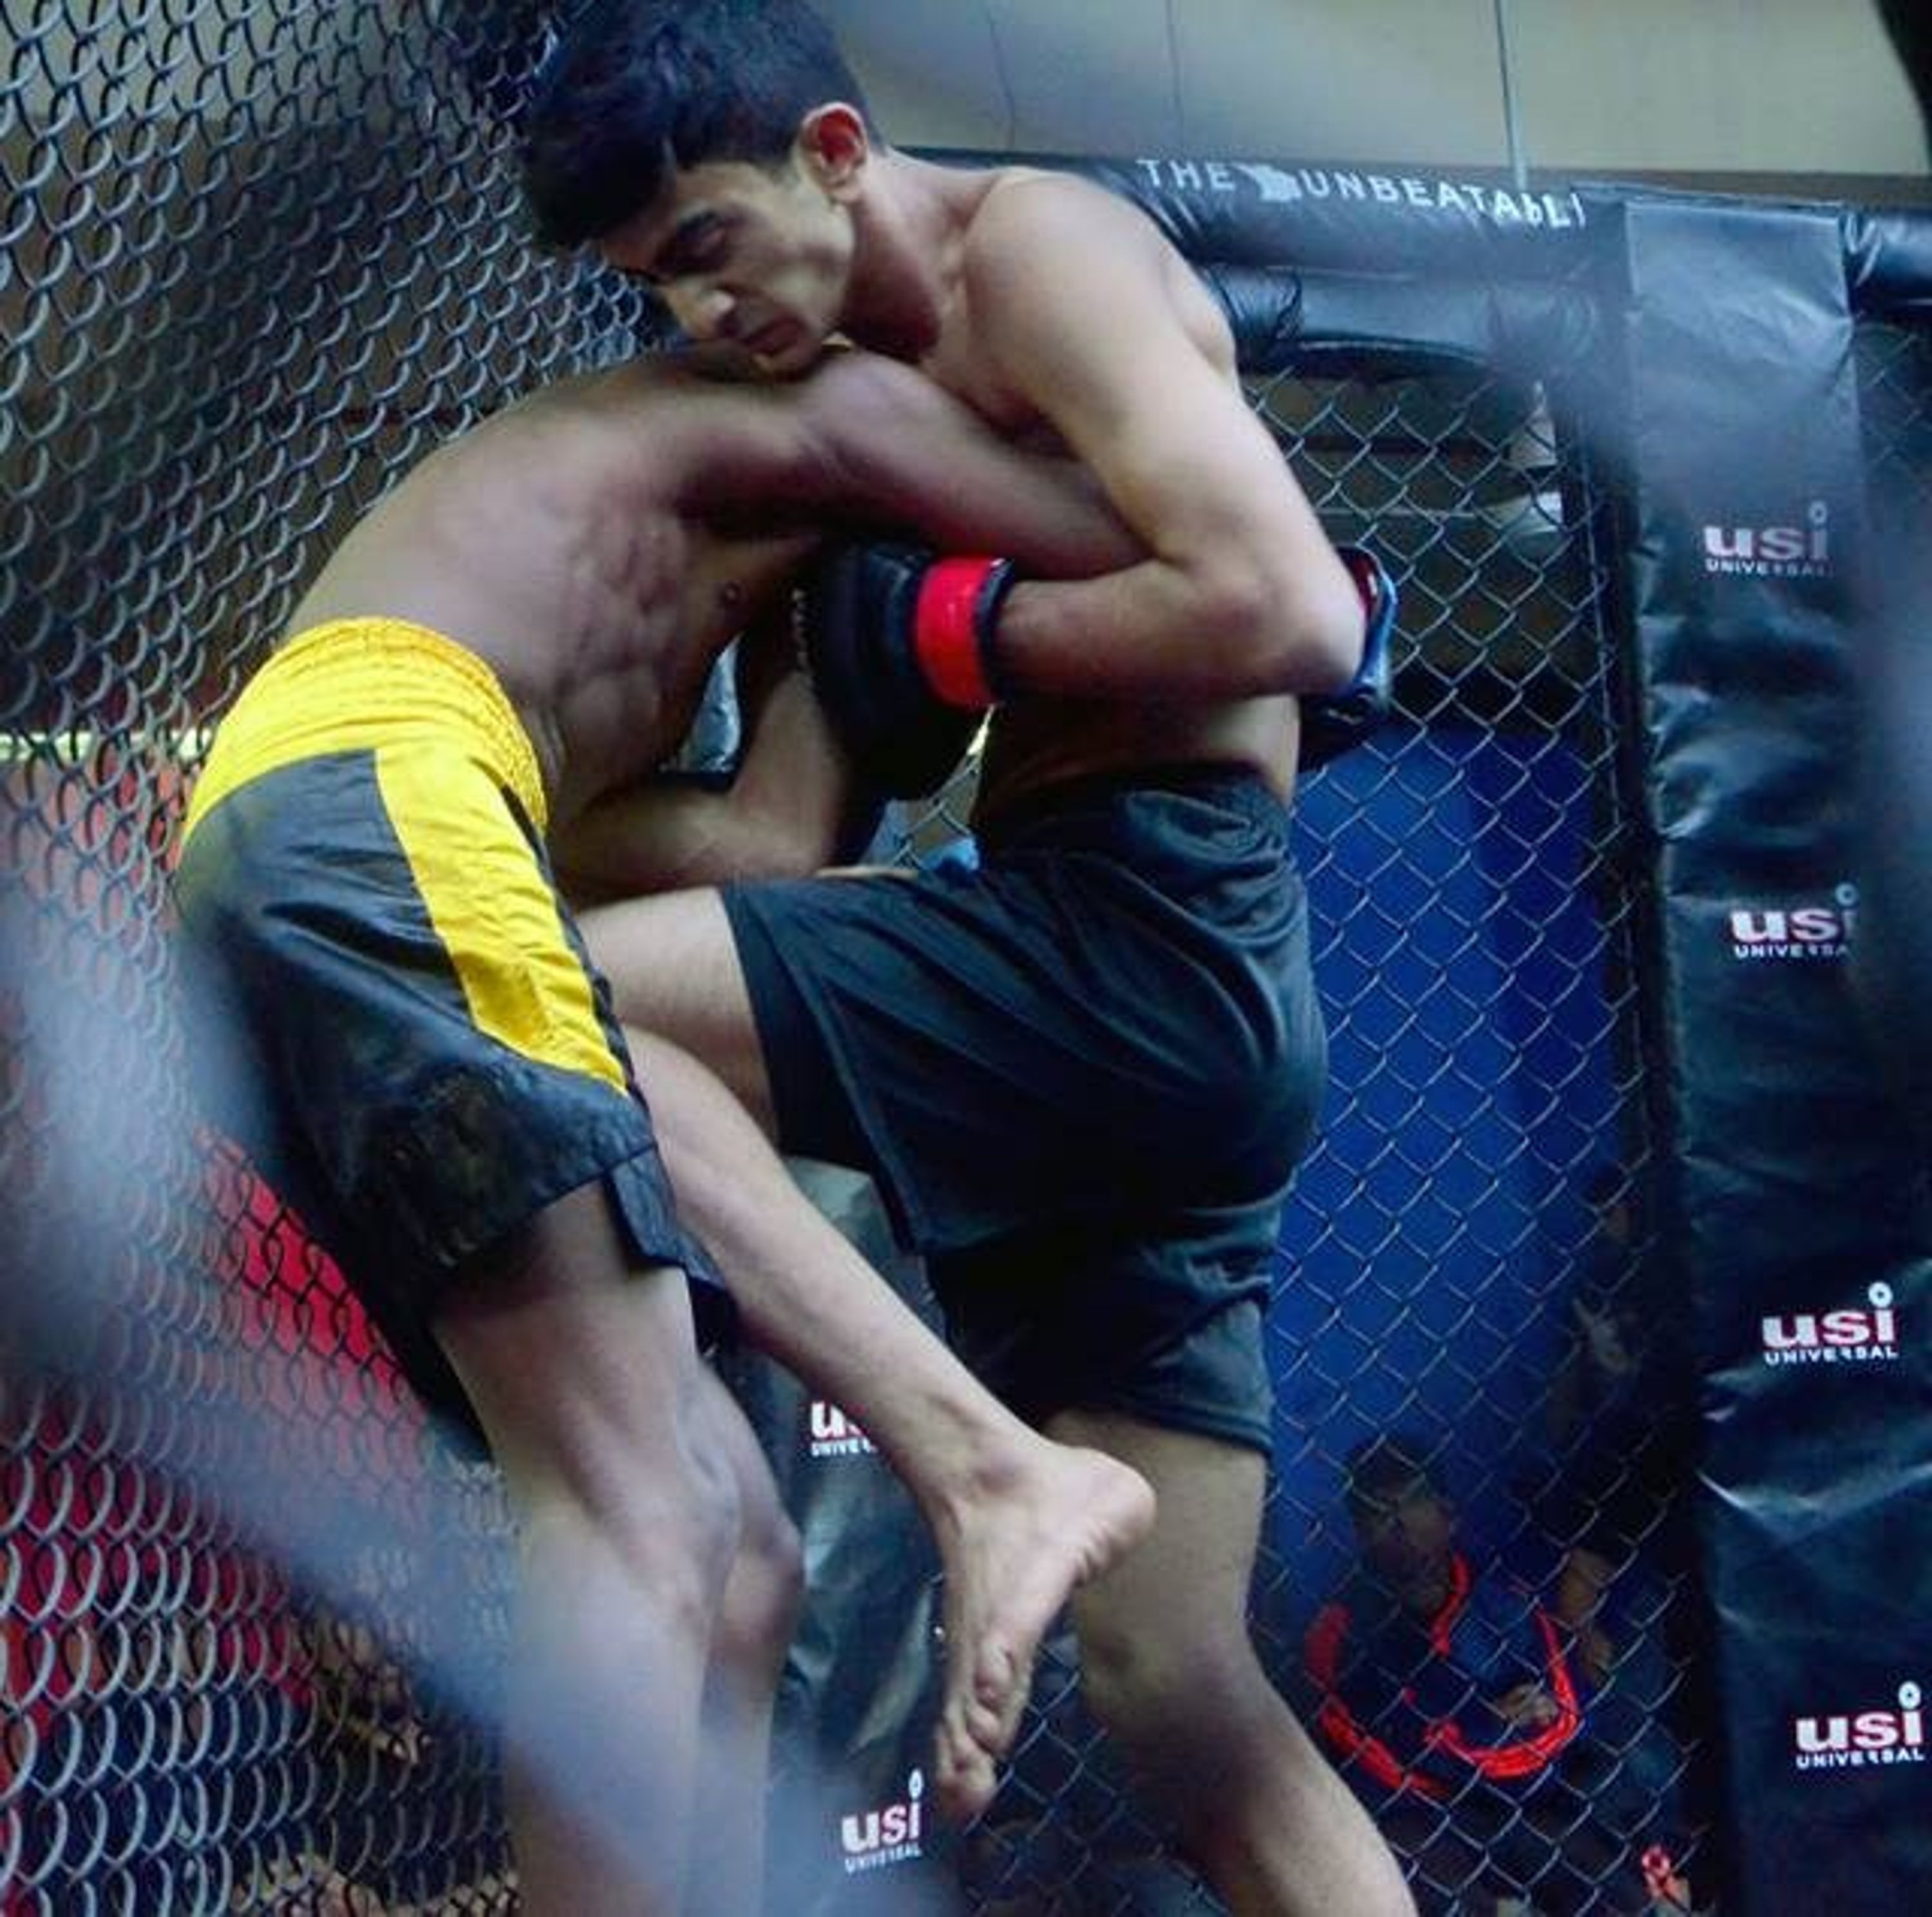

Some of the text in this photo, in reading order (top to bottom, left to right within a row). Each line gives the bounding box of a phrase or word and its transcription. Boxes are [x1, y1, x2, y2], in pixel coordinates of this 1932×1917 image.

[1135, 159, 1235, 189] THE
[1703, 500, 1829, 560] usi
[1734, 944, 1850, 959] UNIVERSA
[1762, 1281, 1895, 1347] usi
[1796, 1681, 1922, 1752] usi
[842, 1768, 922, 1853] usi
